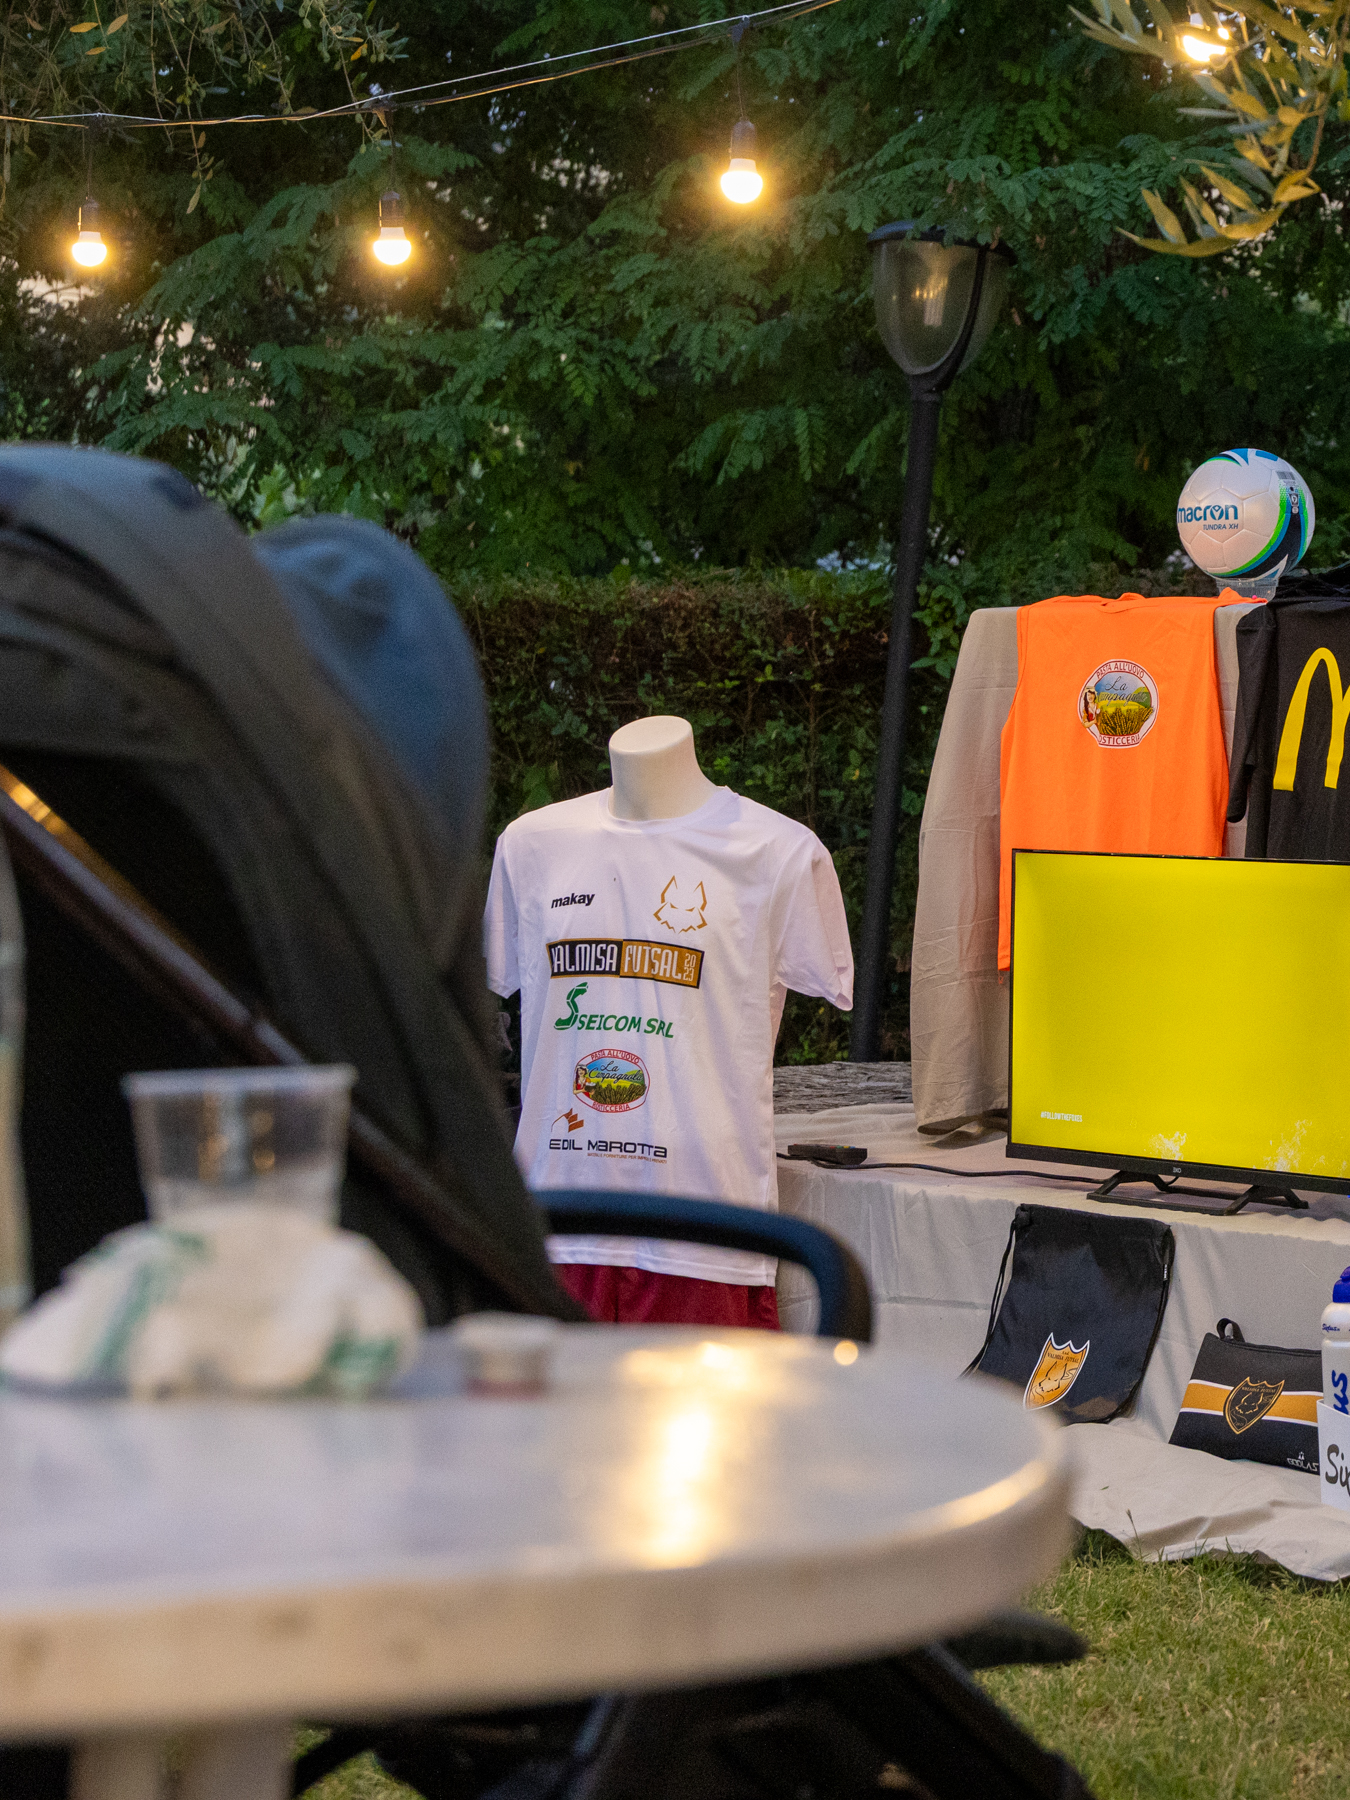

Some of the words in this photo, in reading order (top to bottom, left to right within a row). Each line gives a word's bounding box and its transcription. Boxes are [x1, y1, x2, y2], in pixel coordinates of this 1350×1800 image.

[1177, 504, 1239, 524] macron
[1096, 663, 1112, 679] PASTA
[1113, 662, 1145, 679] ALL'UOVO
[1105, 676, 1128, 691] La
[551, 893, 596, 909] makay
[624, 944, 682, 980] FUTSAL
[684, 952, 697, 968] 20
[683, 966, 695, 982] 23
[577, 1014, 642, 1033] SEICOM
[643, 1017, 674, 1039] SRL
[600, 1060, 620, 1072] La
[549, 1138, 583, 1151] EDIL
